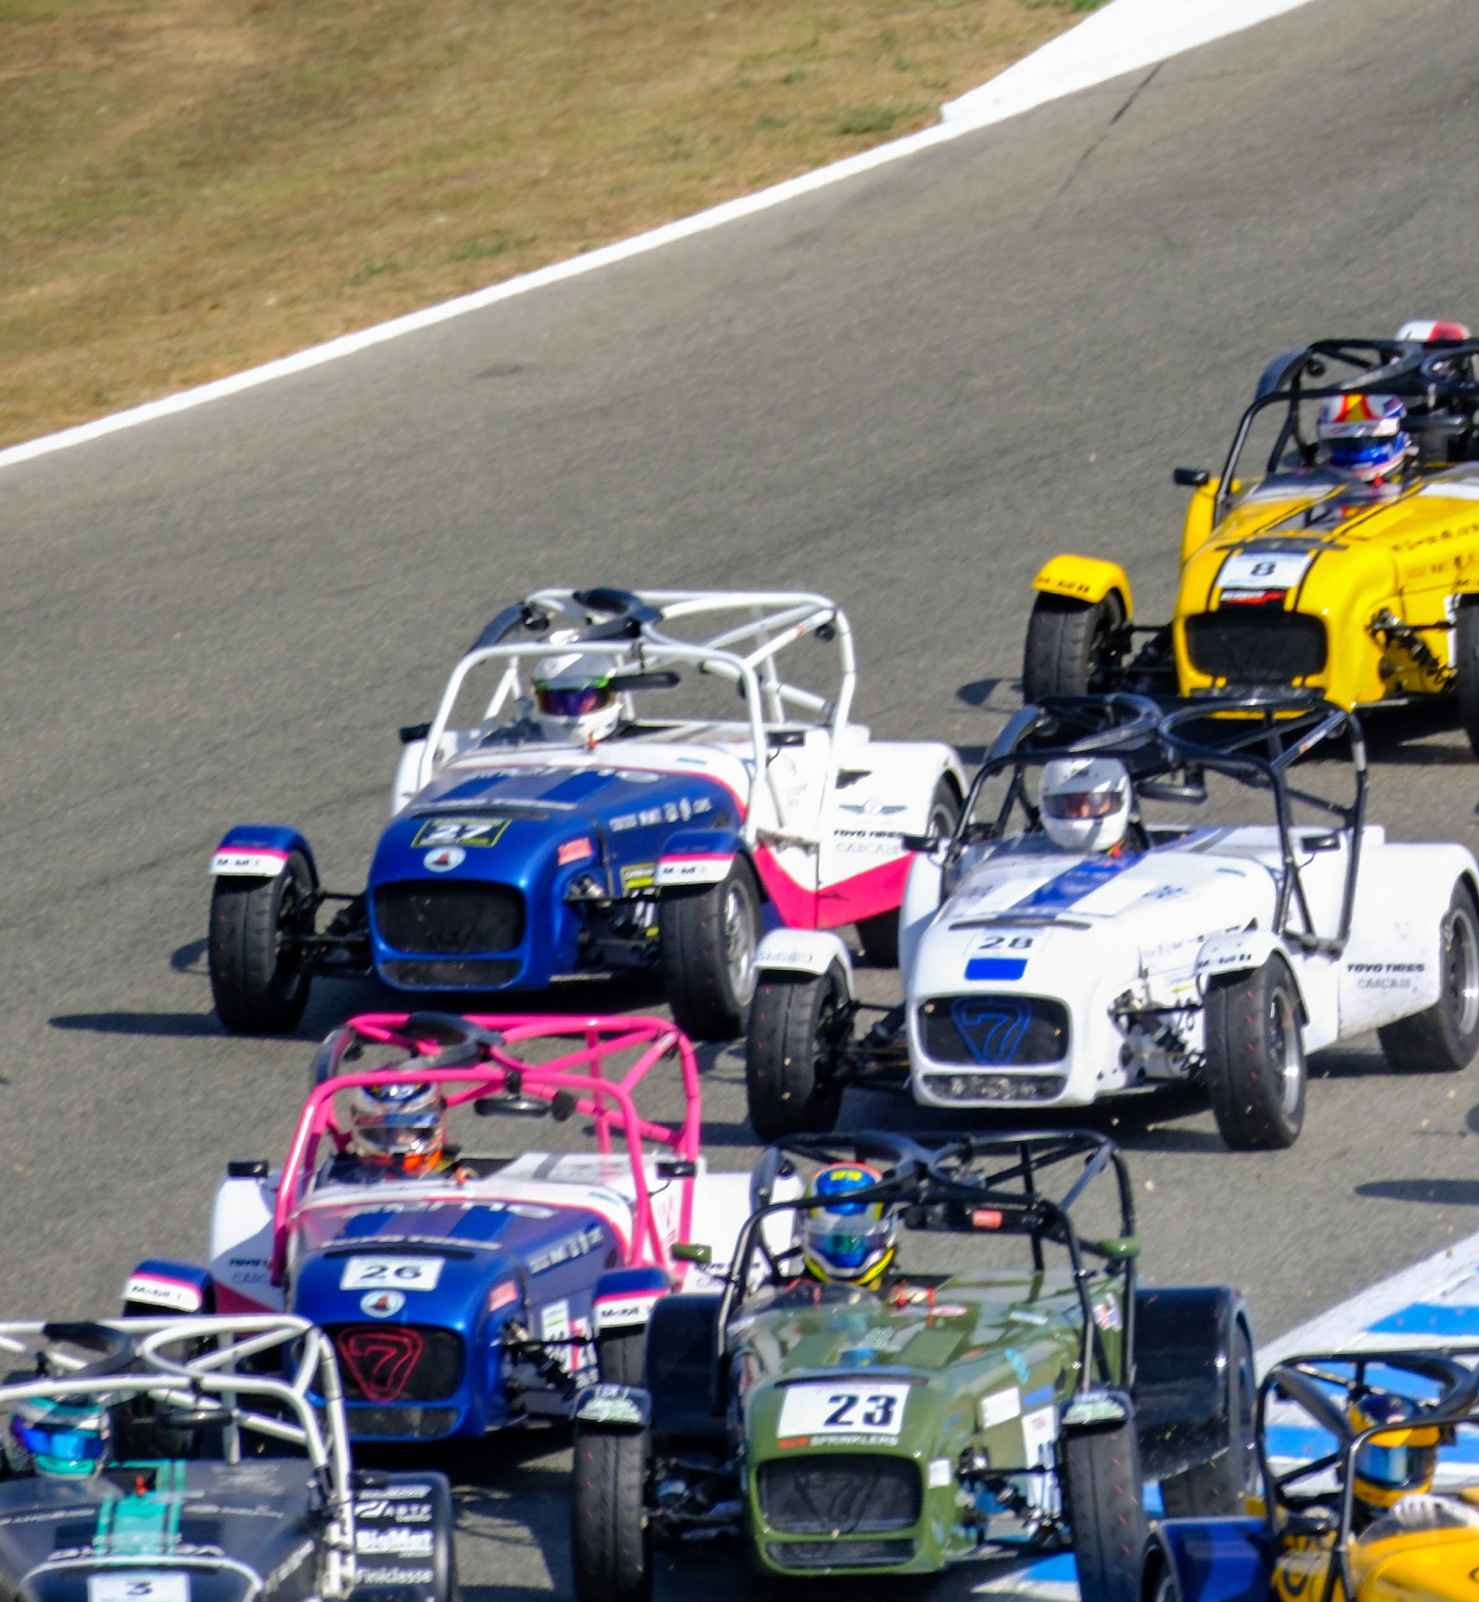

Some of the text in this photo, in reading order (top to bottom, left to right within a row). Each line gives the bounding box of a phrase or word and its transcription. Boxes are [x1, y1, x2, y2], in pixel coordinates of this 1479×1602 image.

[1250, 561, 1276, 577] 8
[427, 824, 495, 841] 27
[978, 936, 1034, 950] 28
[1347, 962, 1425, 973] TOYO TIRES
[360, 1264, 422, 1280] 26
[823, 1394, 898, 1427] 23
[127, 1580, 152, 1596] 3
